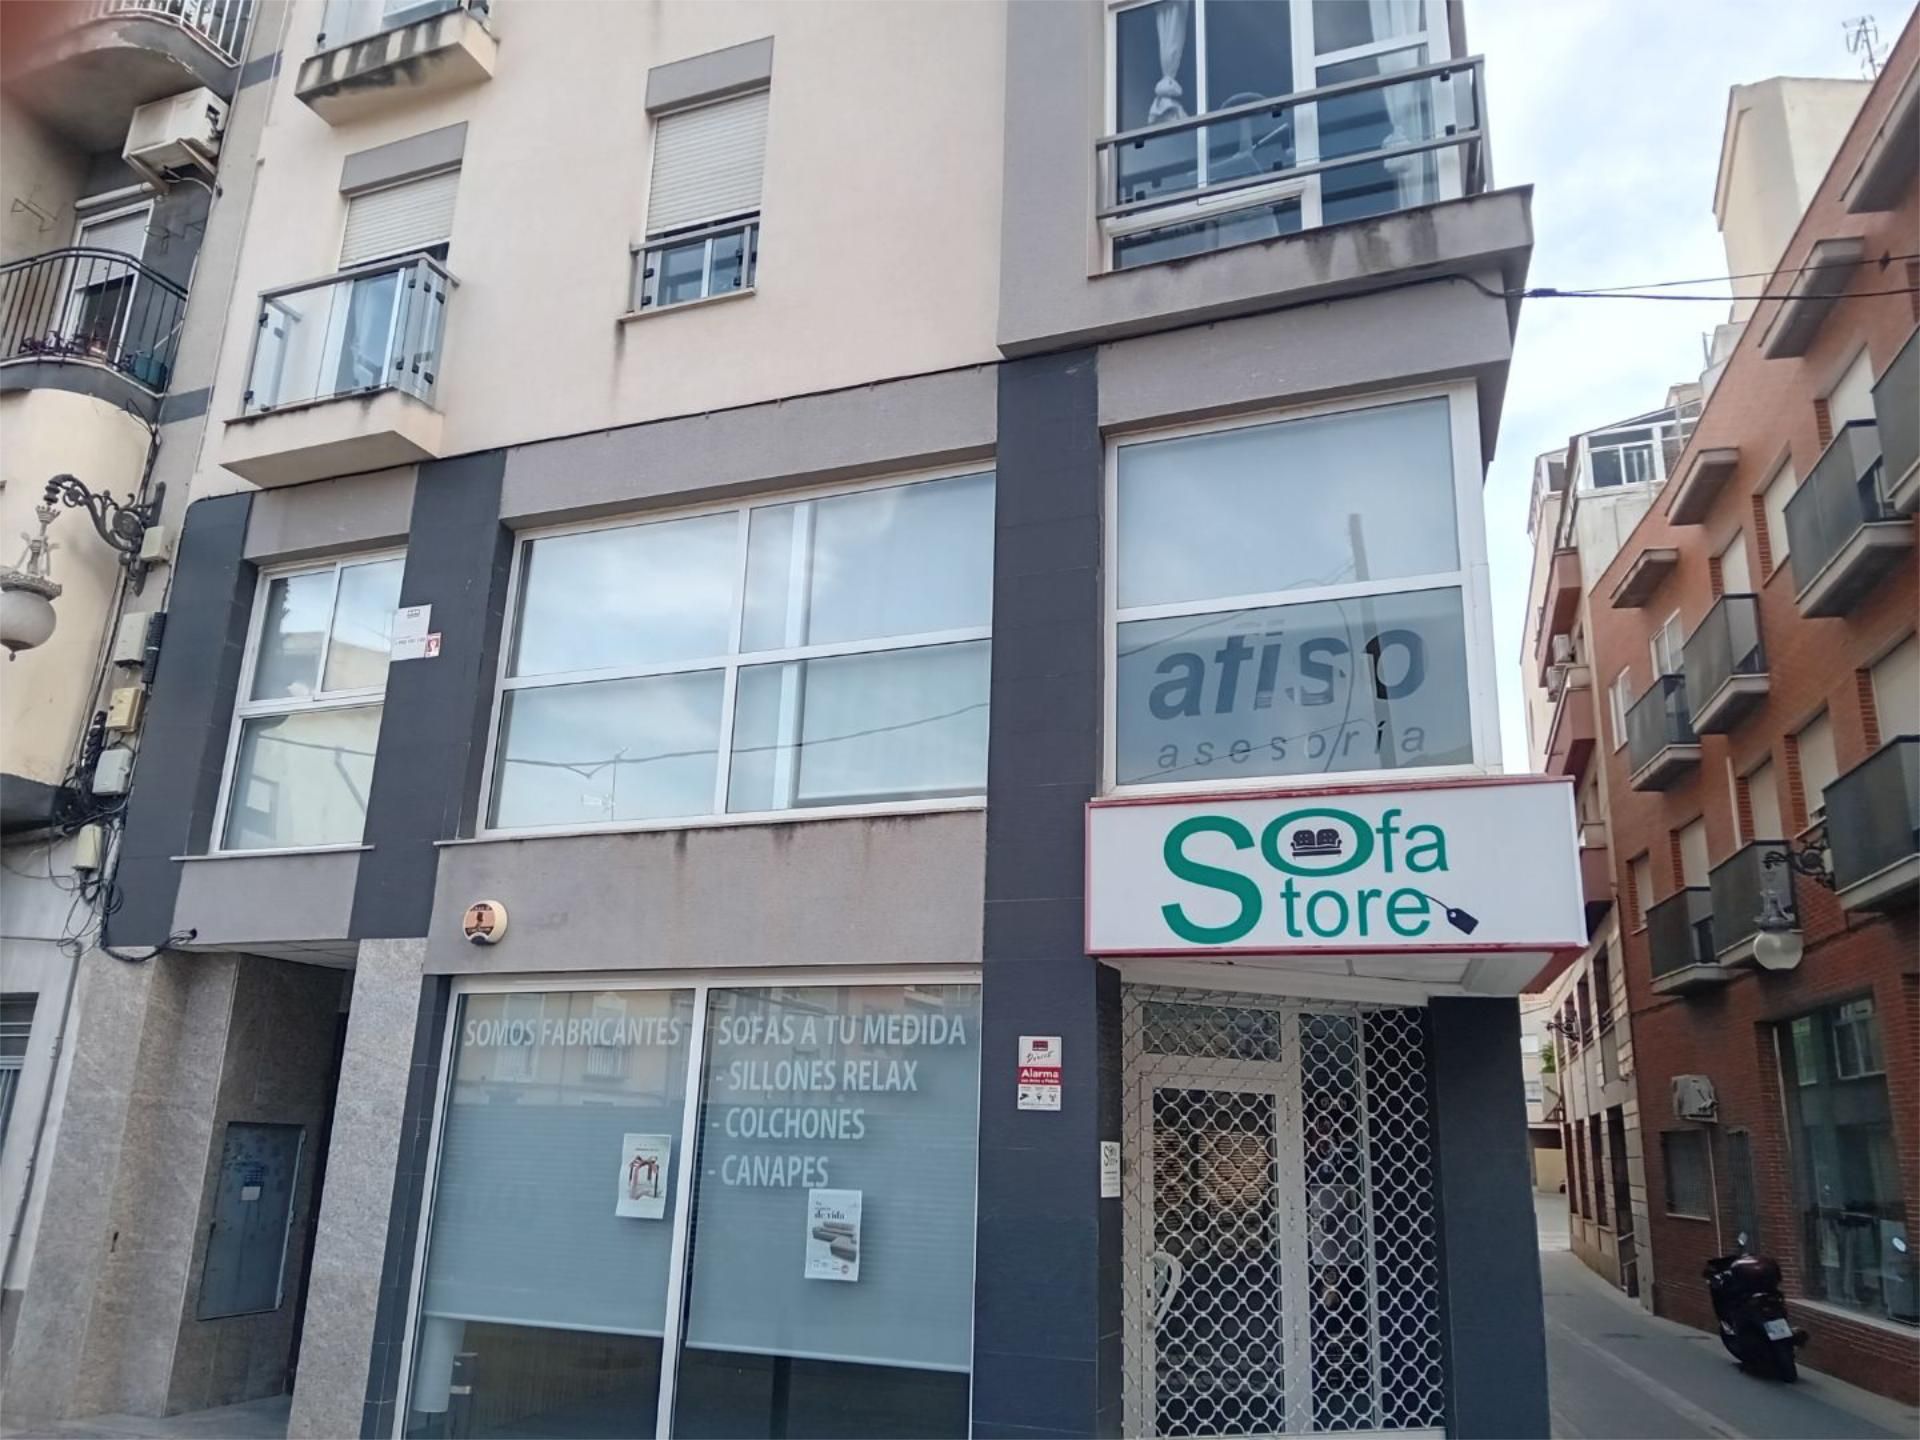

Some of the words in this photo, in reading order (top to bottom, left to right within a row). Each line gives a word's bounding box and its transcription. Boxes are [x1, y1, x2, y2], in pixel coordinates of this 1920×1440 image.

[1157, 720, 1426, 769] asesoría
[464, 1018, 537, 1047] SOMOS
[540, 1016, 681, 1047] FABRICANTES
[718, 1015, 795, 1046] SOFAS
[800, 1016, 818, 1045] A
[827, 1016, 856, 1045] TU
[862, 1014, 967, 1046] MEDIDA
[728, 1060, 836, 1092] SILLONES
[842, 1060, 919, 1092] RELAX
[1021, 1067, 1060, 1079] Alarma
[725, 1107, 866, 1140] COLCHONES
[721, 1154, 830, 1188] CANAPES
